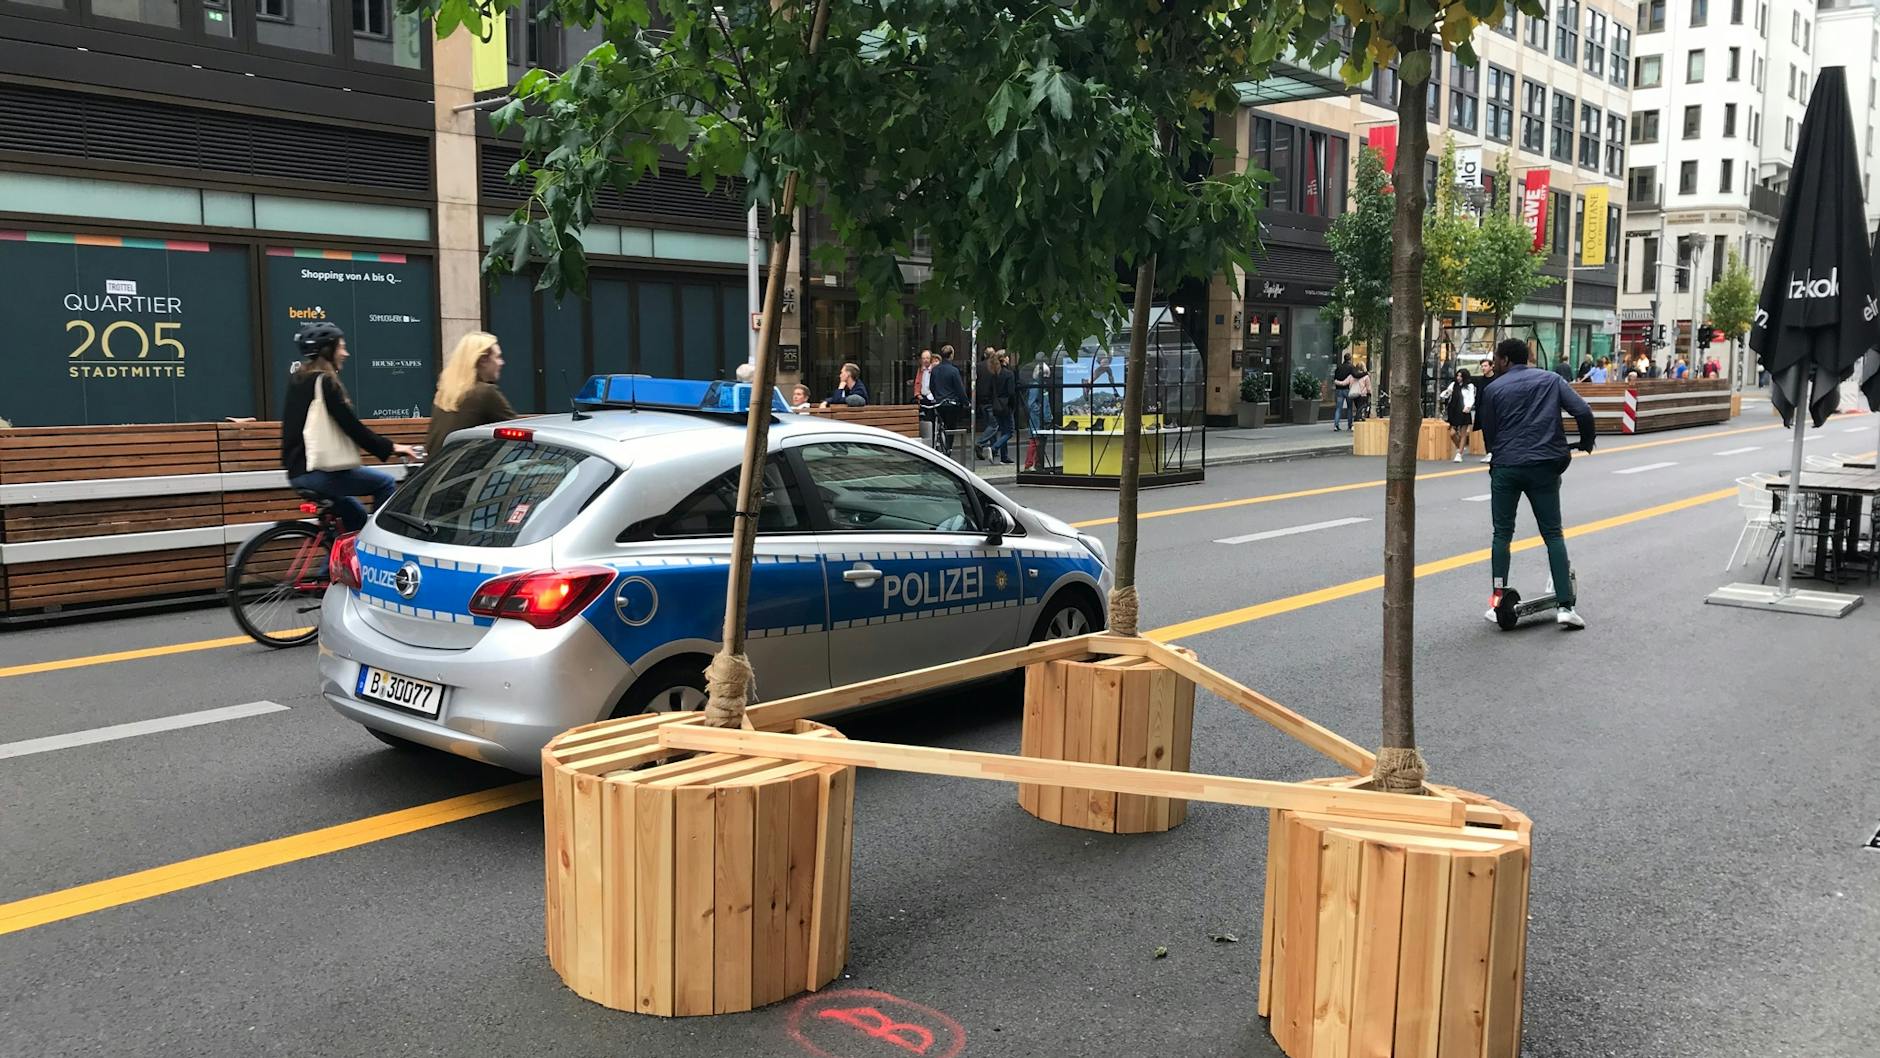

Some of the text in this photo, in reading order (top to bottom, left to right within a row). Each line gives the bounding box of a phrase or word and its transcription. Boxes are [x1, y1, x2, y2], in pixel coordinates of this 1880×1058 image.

[301, 269, 344, 282] Shopping
[345, 273, 361, 281] von
[363, 273, 370, 281] A
[372, 273, 384, 282] bis
[63, 293, 182, 313] QUARTIER
[66, 320, 185, 359] 205
[69, 366, 185, 378] STADTMITTE
[373, 408, 410, 416] APOTHEKE
[883, 566, 984, 609] POLIZEI
[370, 672, 433, 708] B 30077
